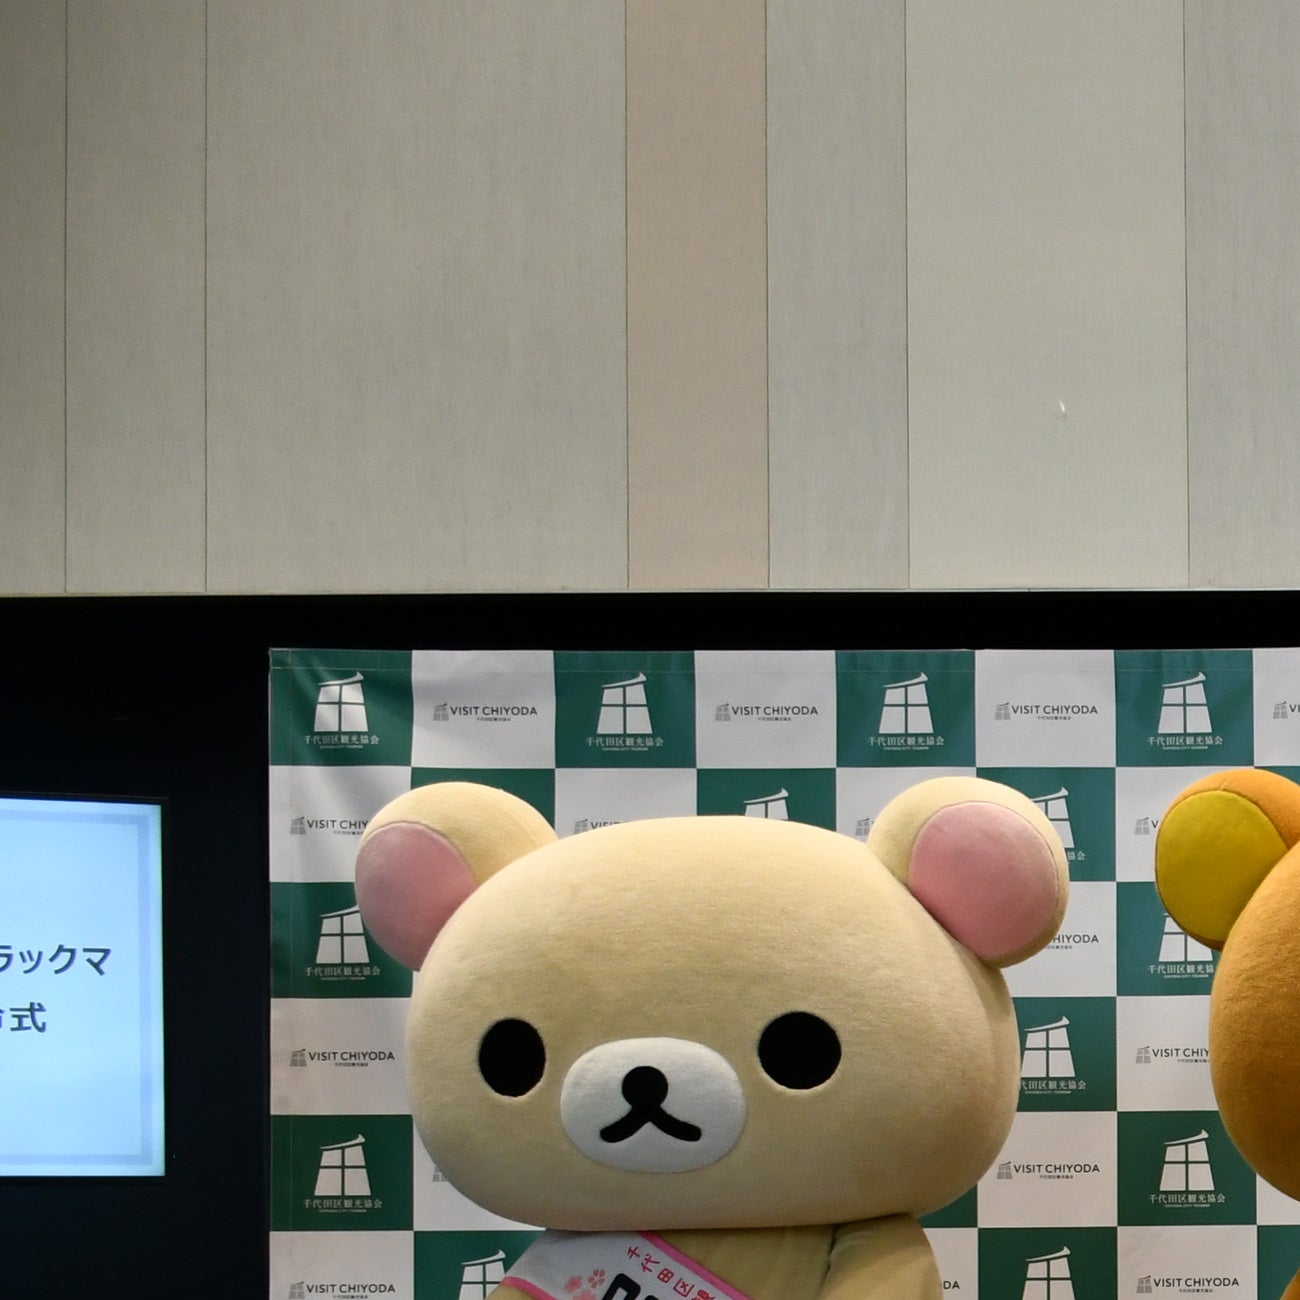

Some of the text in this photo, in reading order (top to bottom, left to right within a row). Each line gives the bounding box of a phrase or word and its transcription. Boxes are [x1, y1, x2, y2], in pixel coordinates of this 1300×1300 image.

[450, 706, 537, 716] VISIT CHIYODA
[731, 704, 818, 716] VISIT CHIYODA
[1011, 704, 1098, 715] VISIT CHIYODA
[307, 820, 369, 829] VISIT CHIY
[1055, 934, 1099, 944] HIYODA
[1148, 964, 1215, 974] 千代田区観光協
[308, 1051, 395, 1061] VISIT CHIYODA
[1152, 1047, 1210, 1058] VISIT CHIY
[1014, 1163, 1100, 1174] VISIT CHIYODA
[1153, 1277, 1239, 1287] VISIT CHIYODA
[306, 1283, 396, 1294] VISIT CHIYODA
